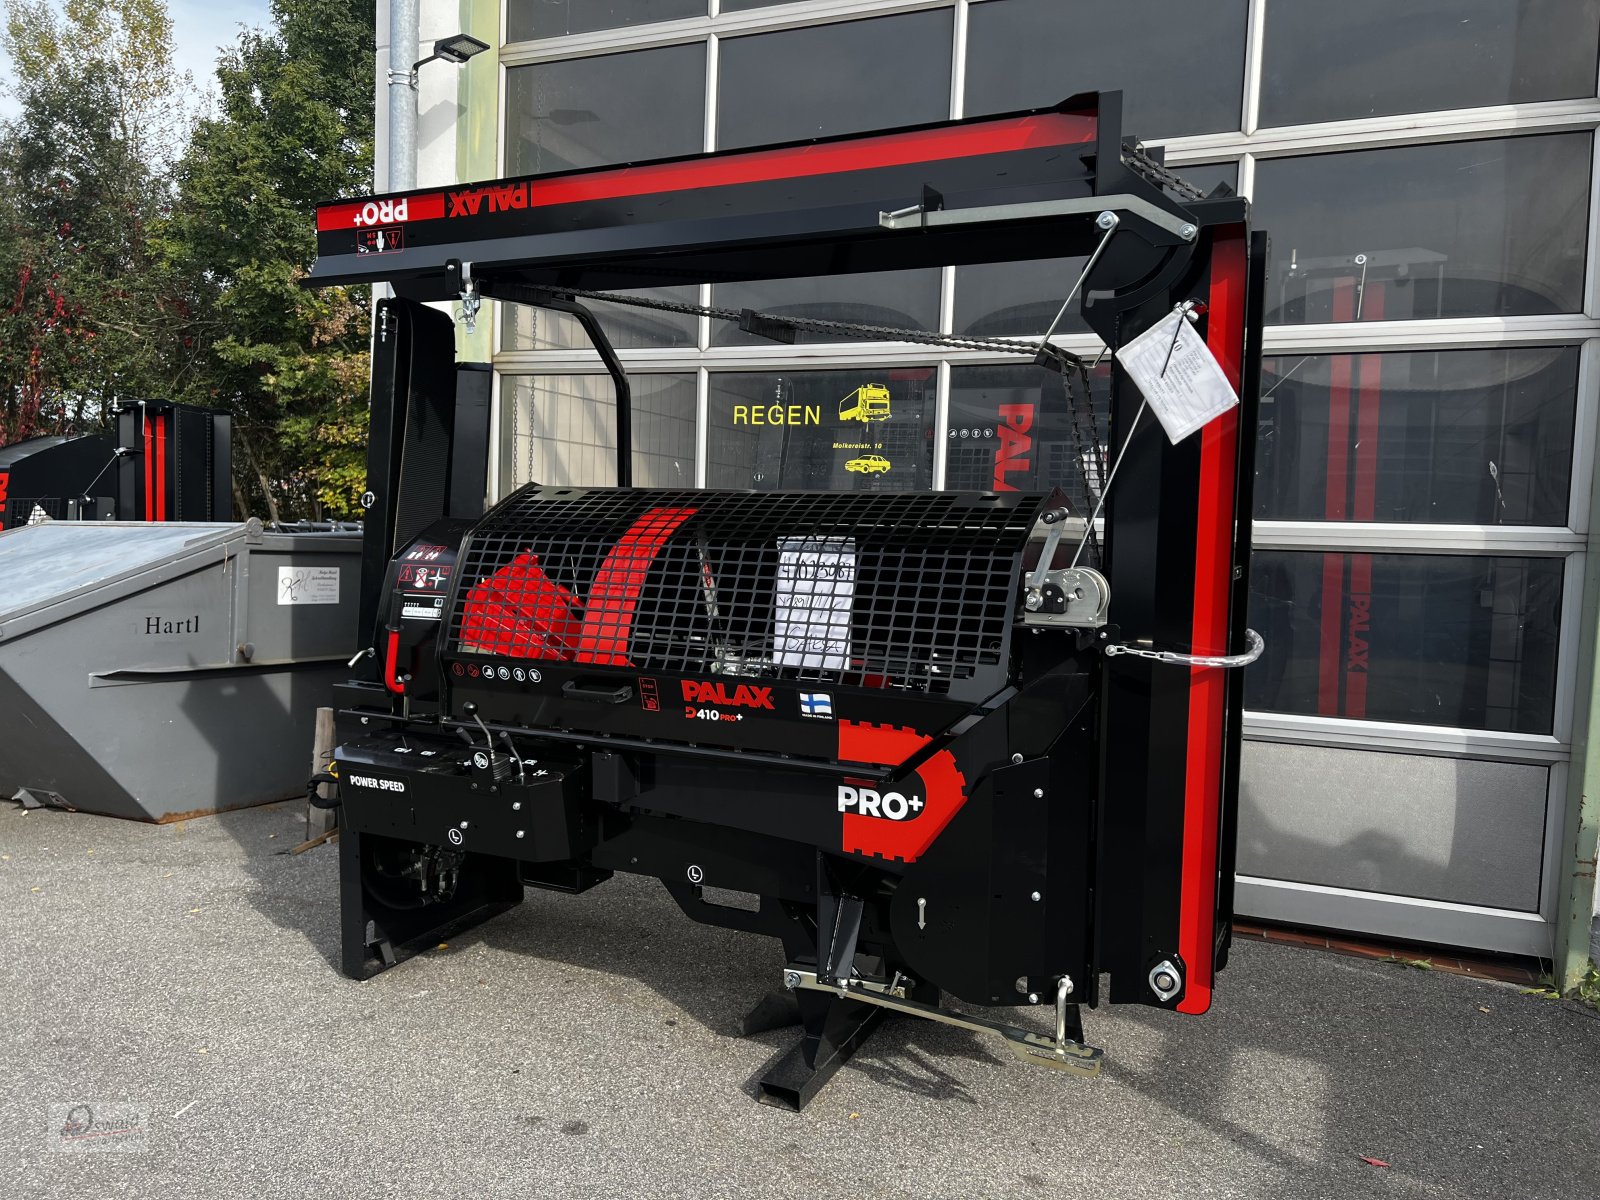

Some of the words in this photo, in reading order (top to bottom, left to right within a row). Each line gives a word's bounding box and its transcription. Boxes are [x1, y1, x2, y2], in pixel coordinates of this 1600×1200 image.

[353, 198, 408, 226] PRO+
[449, 183, 527, 217] PALAX
[733, 405, 820, 425] REGEN
[145, 615, 200, 635] Hartl
[1348, 593, 1370, 671] PALAX
[681, 680, 775, 710] PALAX
[350, 775, 379, 789] POWER
[379, 780, 405, 792] SPEED
[837, 785, 924, 820] PRO+
